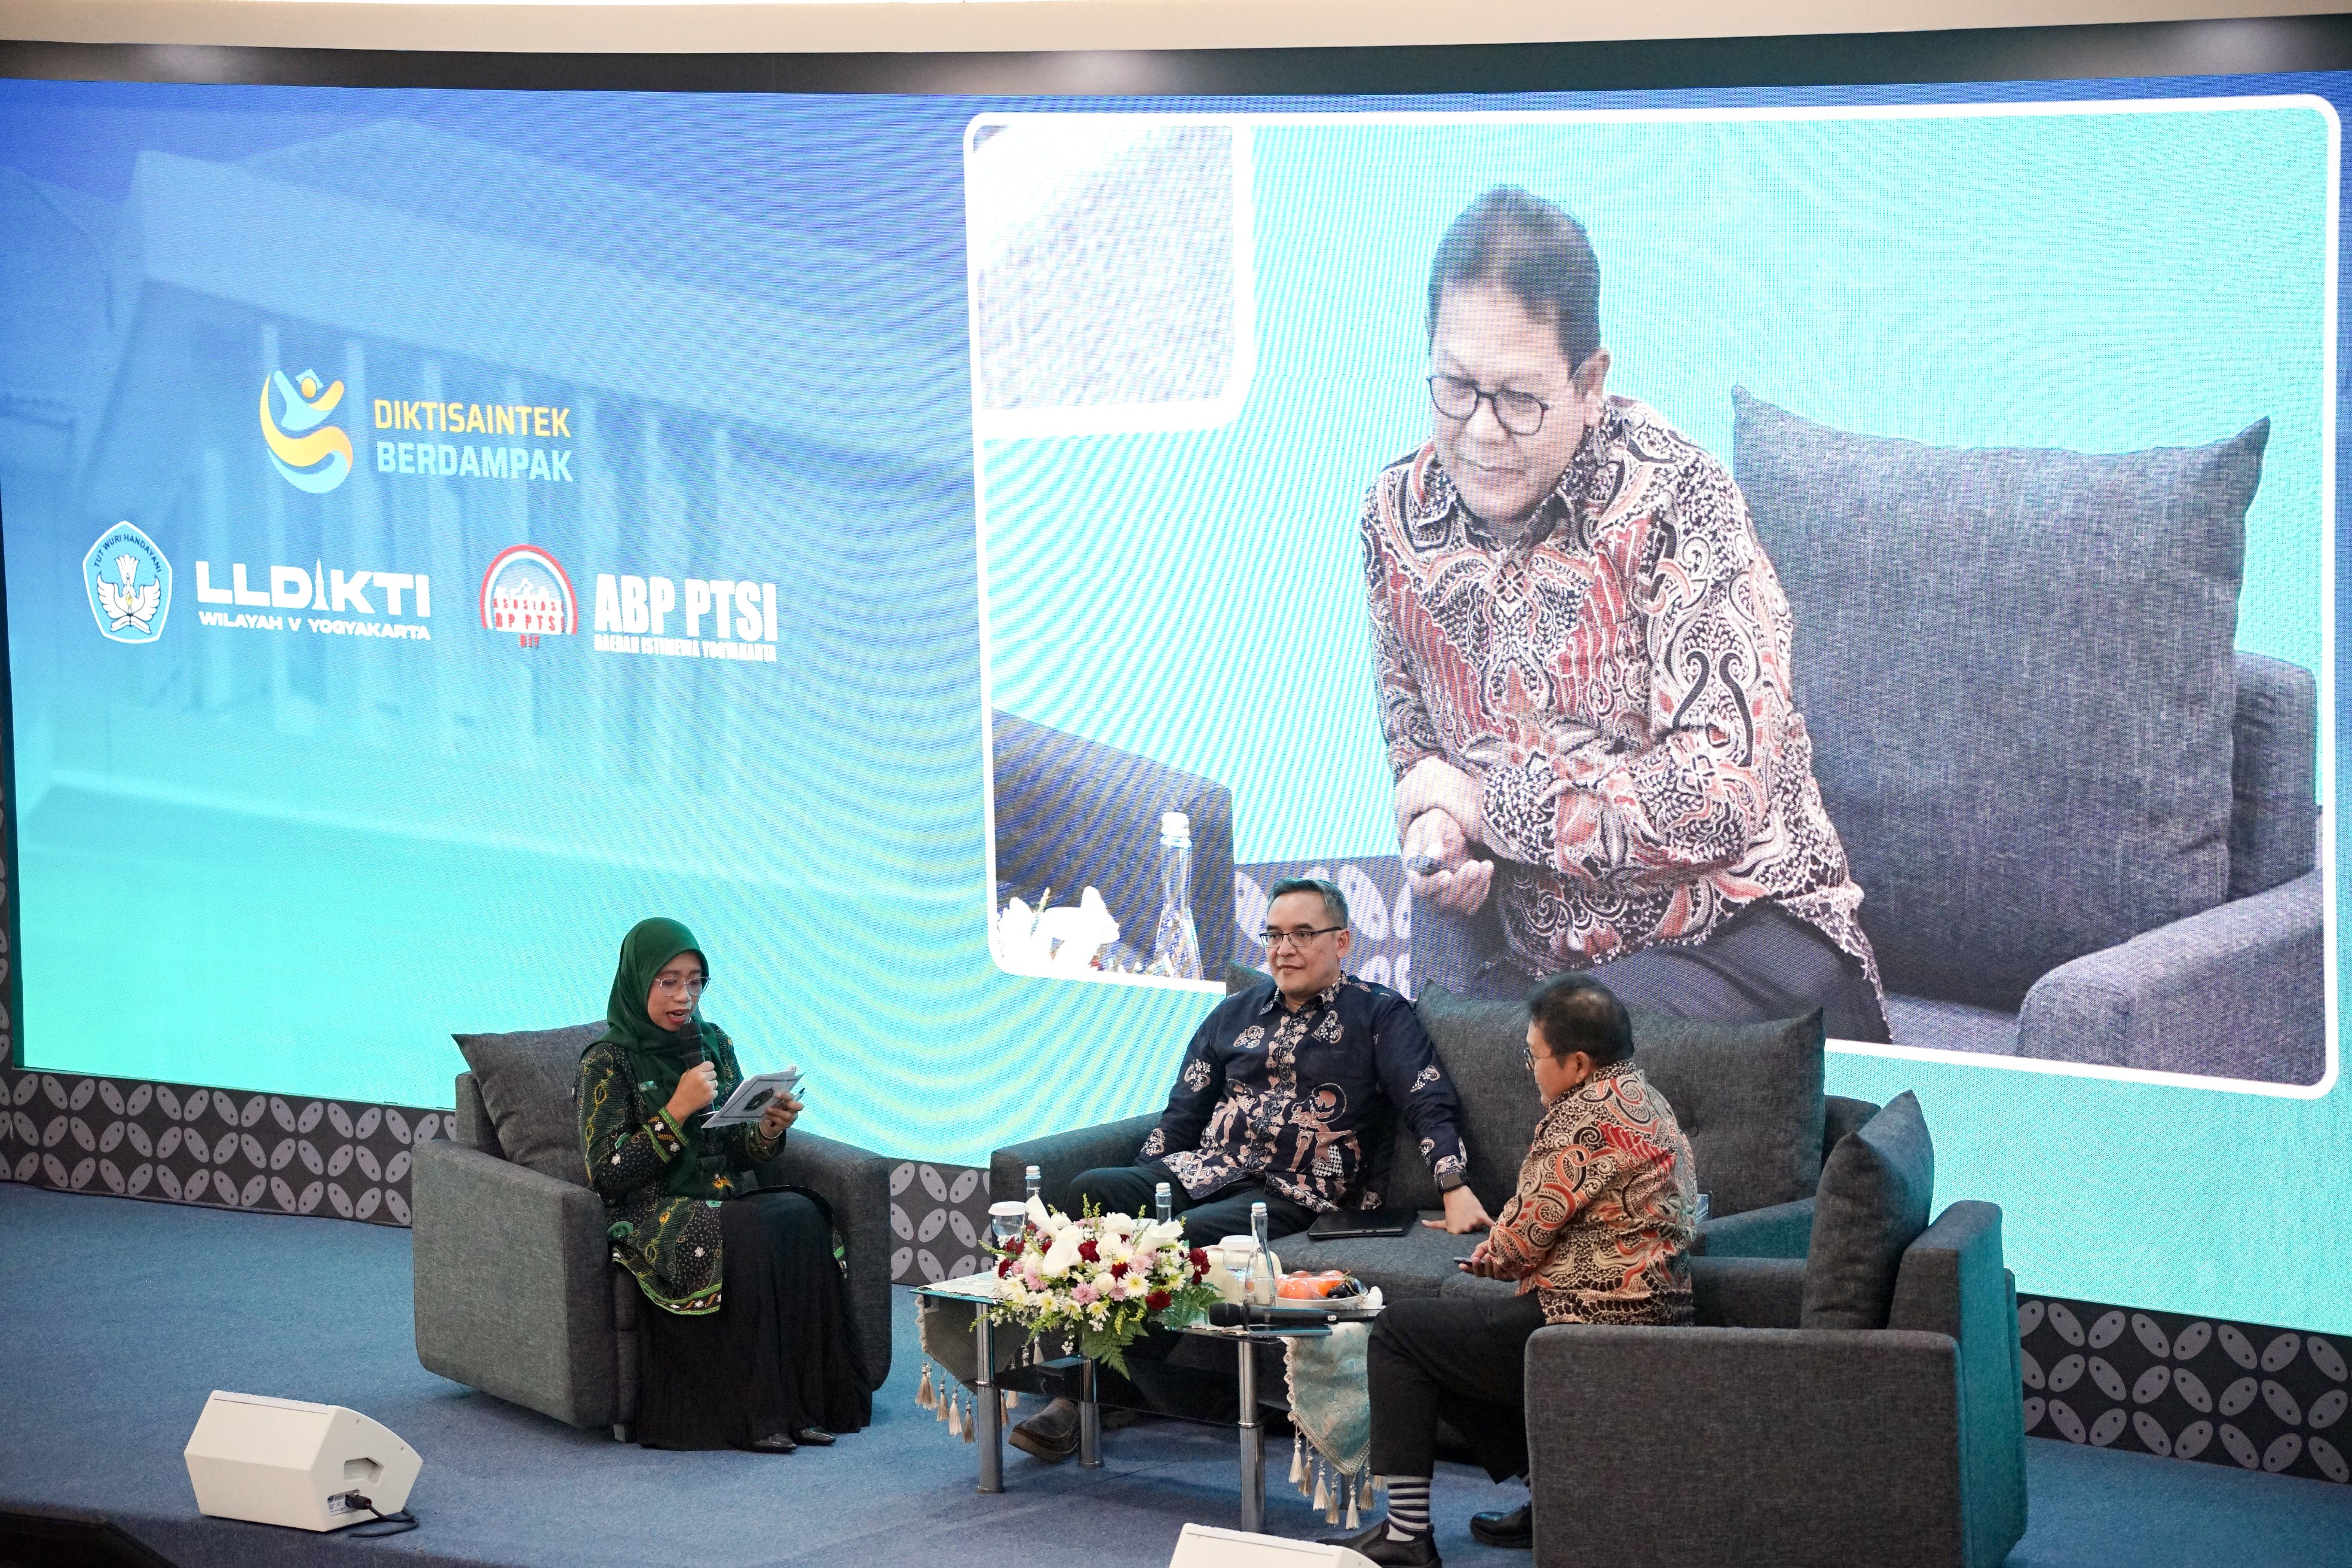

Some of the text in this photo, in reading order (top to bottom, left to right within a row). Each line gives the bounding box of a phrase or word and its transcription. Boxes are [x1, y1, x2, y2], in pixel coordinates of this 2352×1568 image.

[374, 399, 571, 437] DIKTISAINTEK
[376, 441, 573, 482] BERDAMPAK
[94, 533, 162, 573] TUT WURI HANDAYANI
[198, 611, 431, 641] WILAYAH V YOGYAKARTA
[595, 573, 778, 642] ABP PTSI
